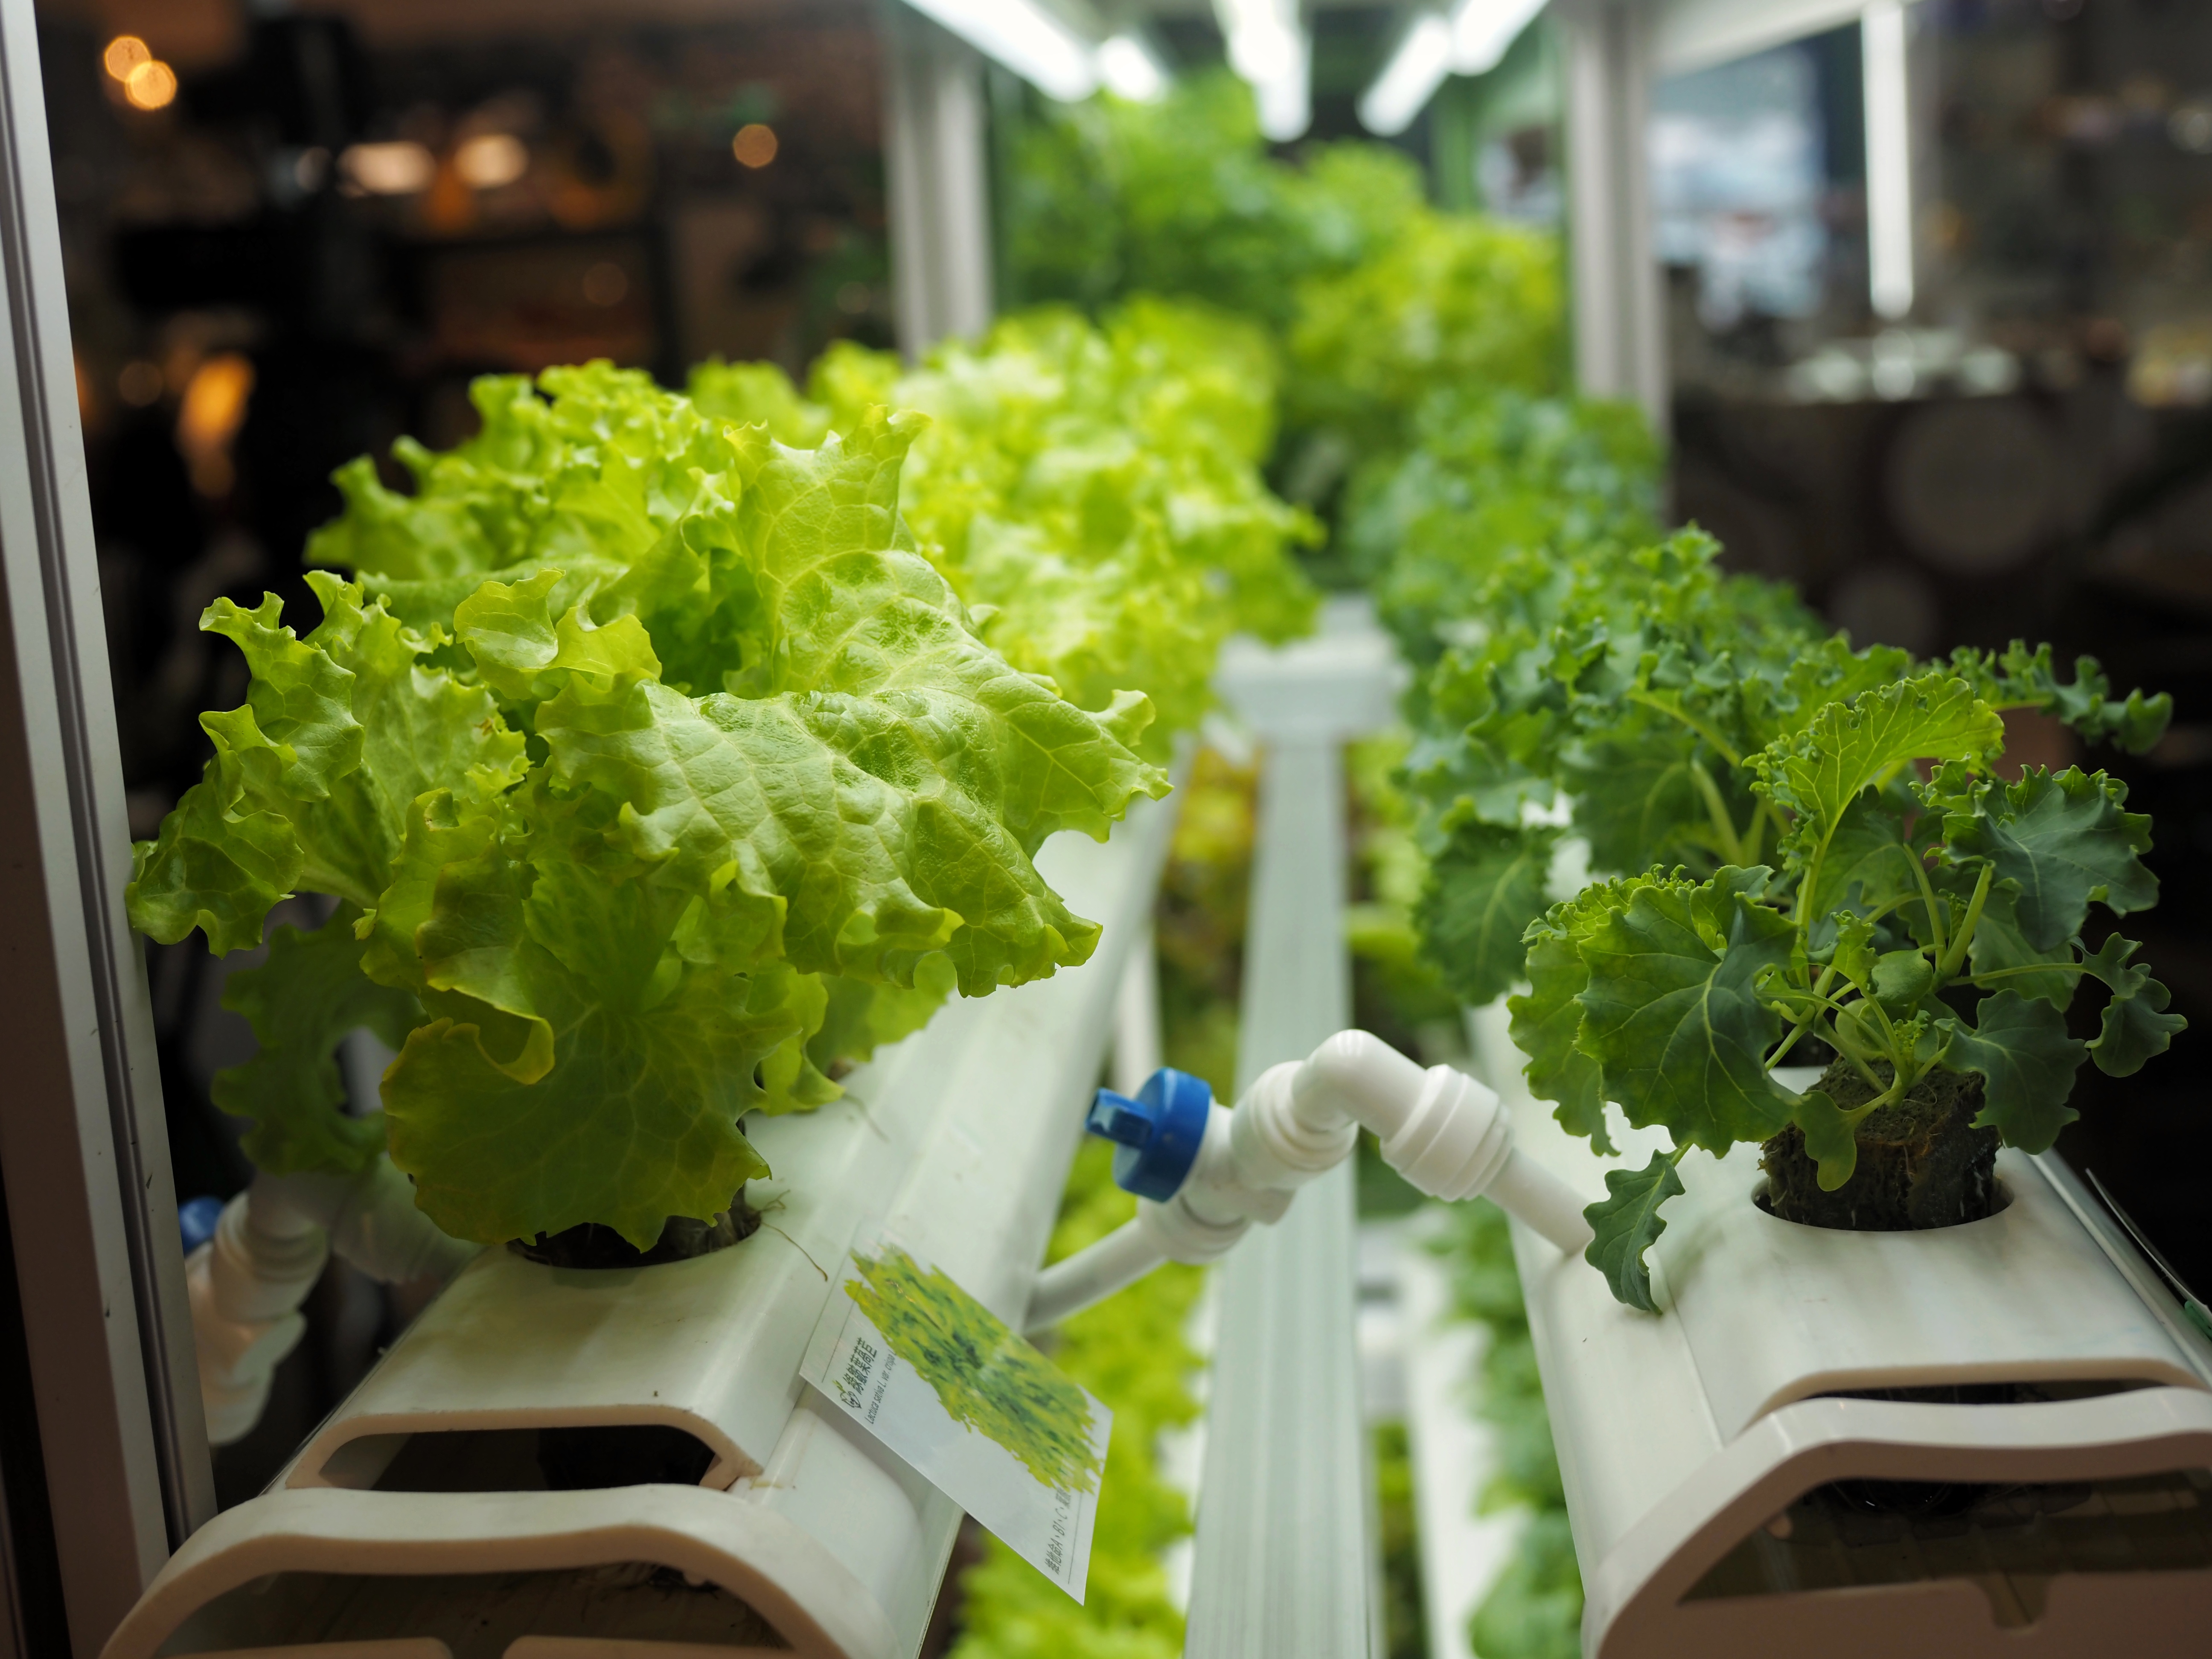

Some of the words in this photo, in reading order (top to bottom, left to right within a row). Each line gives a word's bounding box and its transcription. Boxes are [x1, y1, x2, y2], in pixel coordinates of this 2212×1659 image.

[842, 1337, 877, 1395] 綠皺葉萵苣
[884, 1354, 896, 1371] crispa
[877, 1380, 887, 1388] L.
[881, 1370, 891, 1382] var.
[874, 1385, 885, 1403] sativa
[864, 1401, 879, 1424] Lactuca
